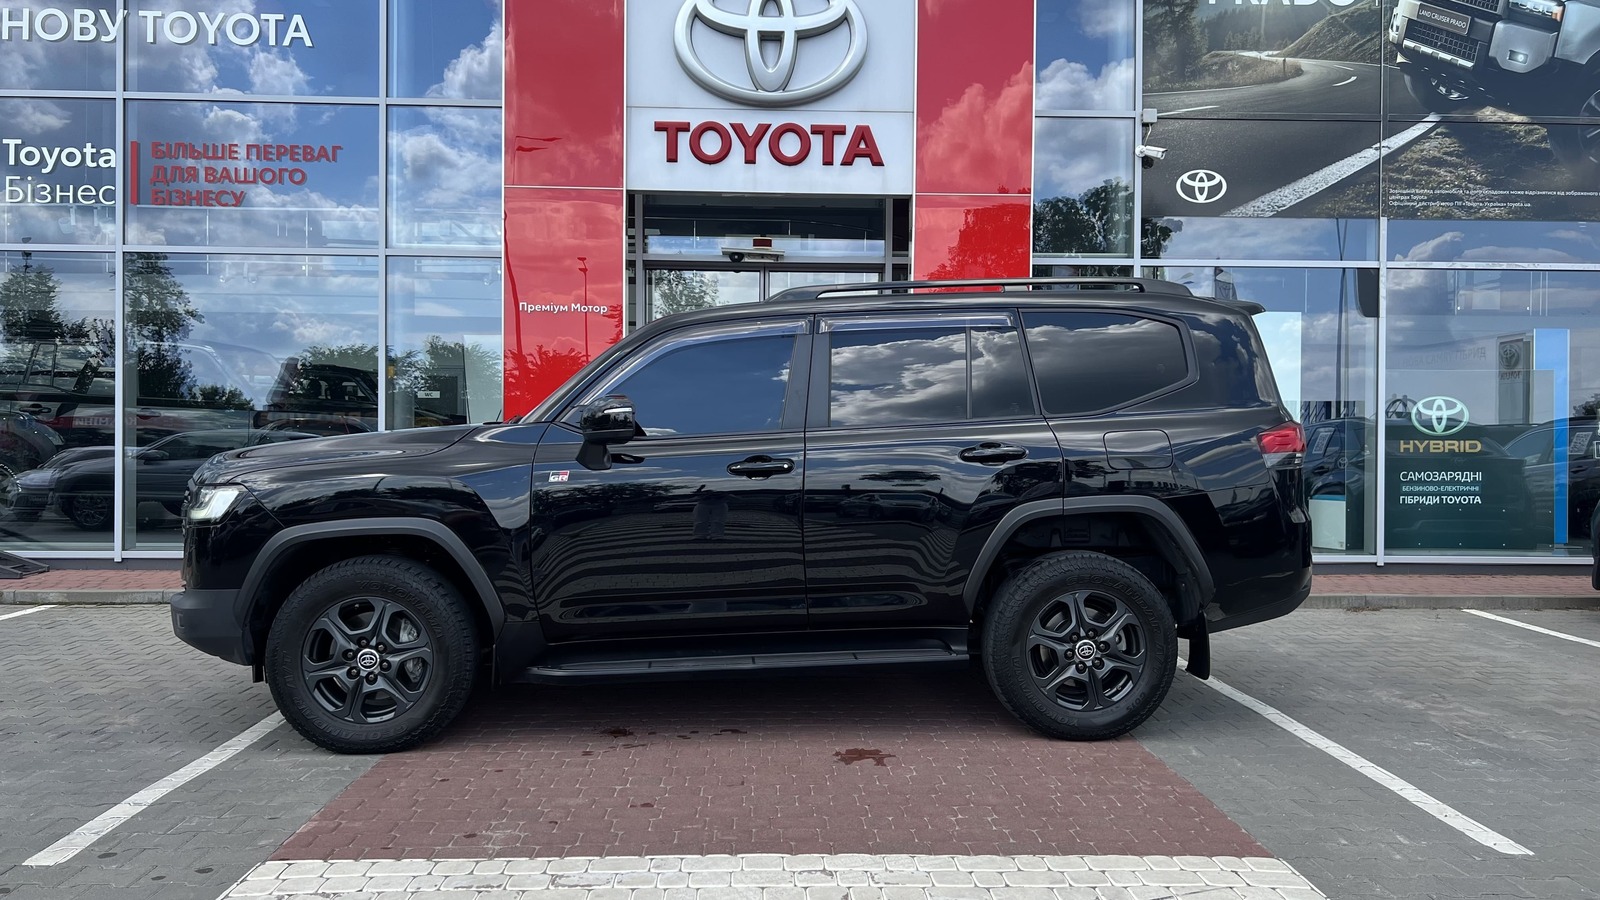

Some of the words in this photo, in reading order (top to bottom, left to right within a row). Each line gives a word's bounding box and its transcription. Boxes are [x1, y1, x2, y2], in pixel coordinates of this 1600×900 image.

[2, 8, 128, 42] НОВУ
[139, 11, 313, 47] TOYOTA
[1431, 13, 1450, 23] CRUISER
[1450, 18, 1466, 28] PRADO
[151, 142, 239, 160] БІЛЬШЕ
[246, 144, 342, 161] ПЕРЕВАГ
[654, 121, 884, 166] TOYOTA
[3, 139, 116, 173] Toyota
[150, 165, 198, 184] ДЛЯ
[204, 167, 306, 184] ВАШОГО
[5, 176, 116, 204] Бізнес
[151, 189, 244, 207] БІЗНЕСУ
[519, 302, 568, 314] Преміум
[571, 303, 608, 314] Мотор
[1400, 440, 1482, 453] HYBRID
[549, 472, 569, 482] GR
[1400, 472, 1482, 482] САМОЗАРЯДНІ
[1400, 496, 1440, 505] ГІБРИДИ
[1441, 496, 1482, 504] TOYOTA
[355, 579, 443, 639] YOKOHAMA
